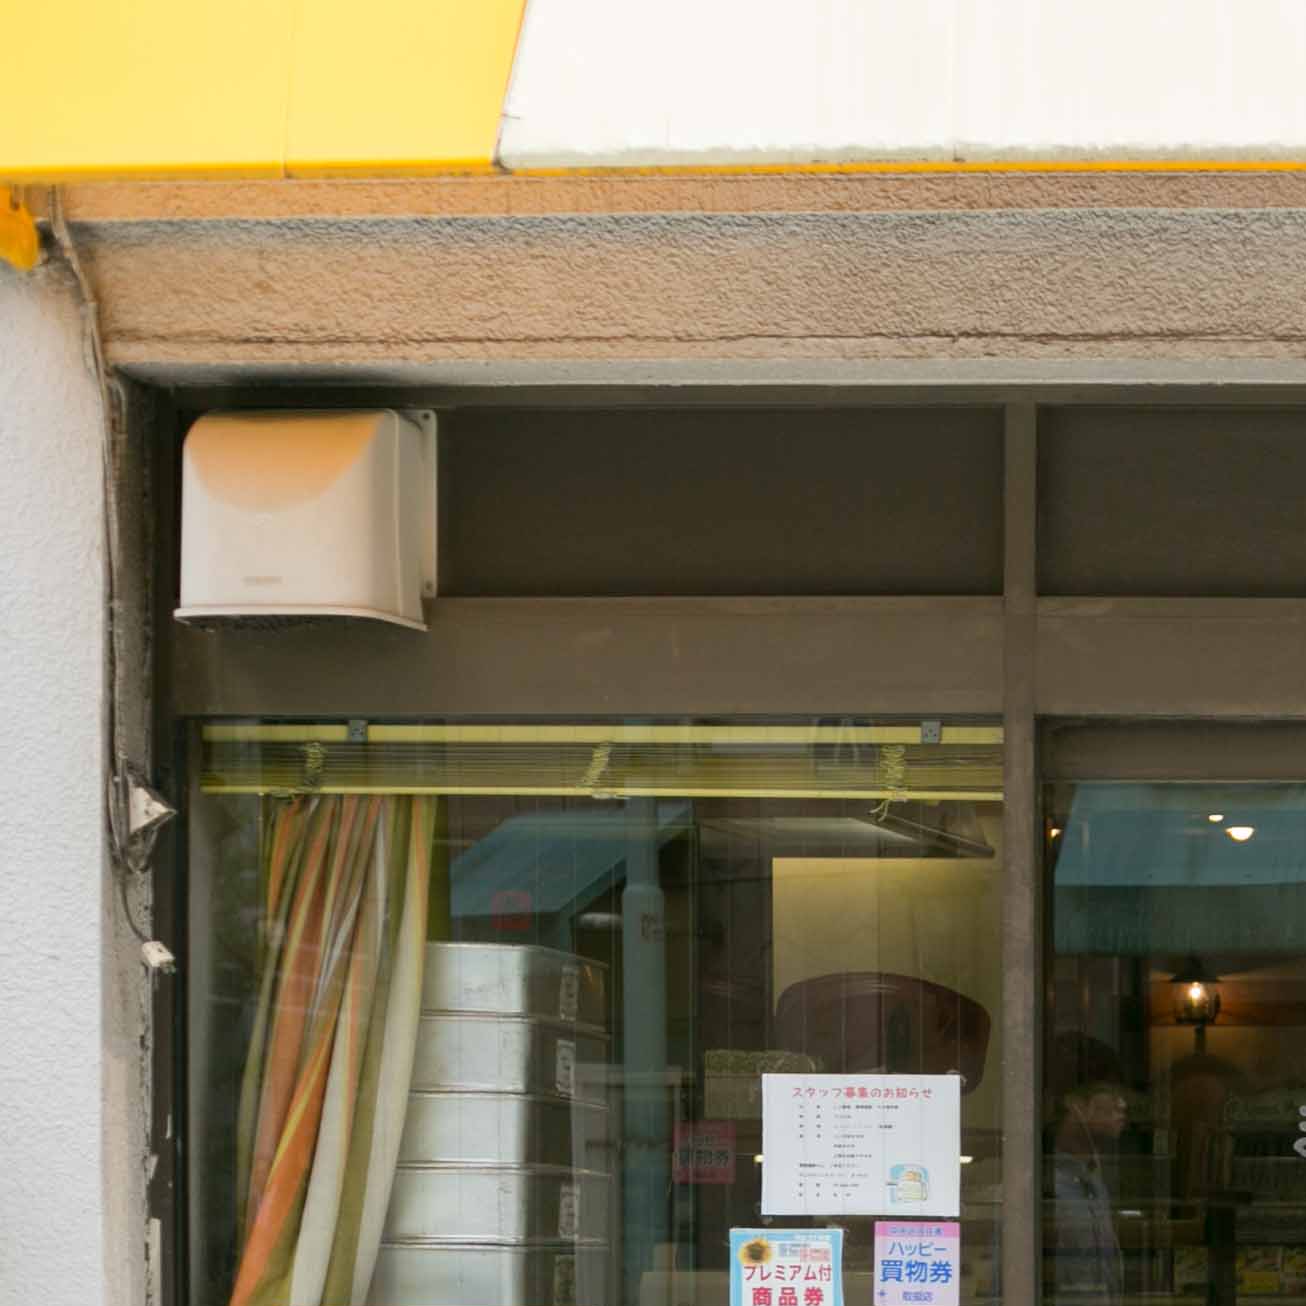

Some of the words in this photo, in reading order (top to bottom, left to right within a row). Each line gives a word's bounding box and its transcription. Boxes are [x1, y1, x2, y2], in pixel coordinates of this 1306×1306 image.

[791, 1086, 933, 1099] スタッフ募集のお知らせ
[888, 1241, 947, 1257] ハッピー
[743, 1265, 833, 1283] プレミアム付
[879, 1259, 953, 1284] 買物券
